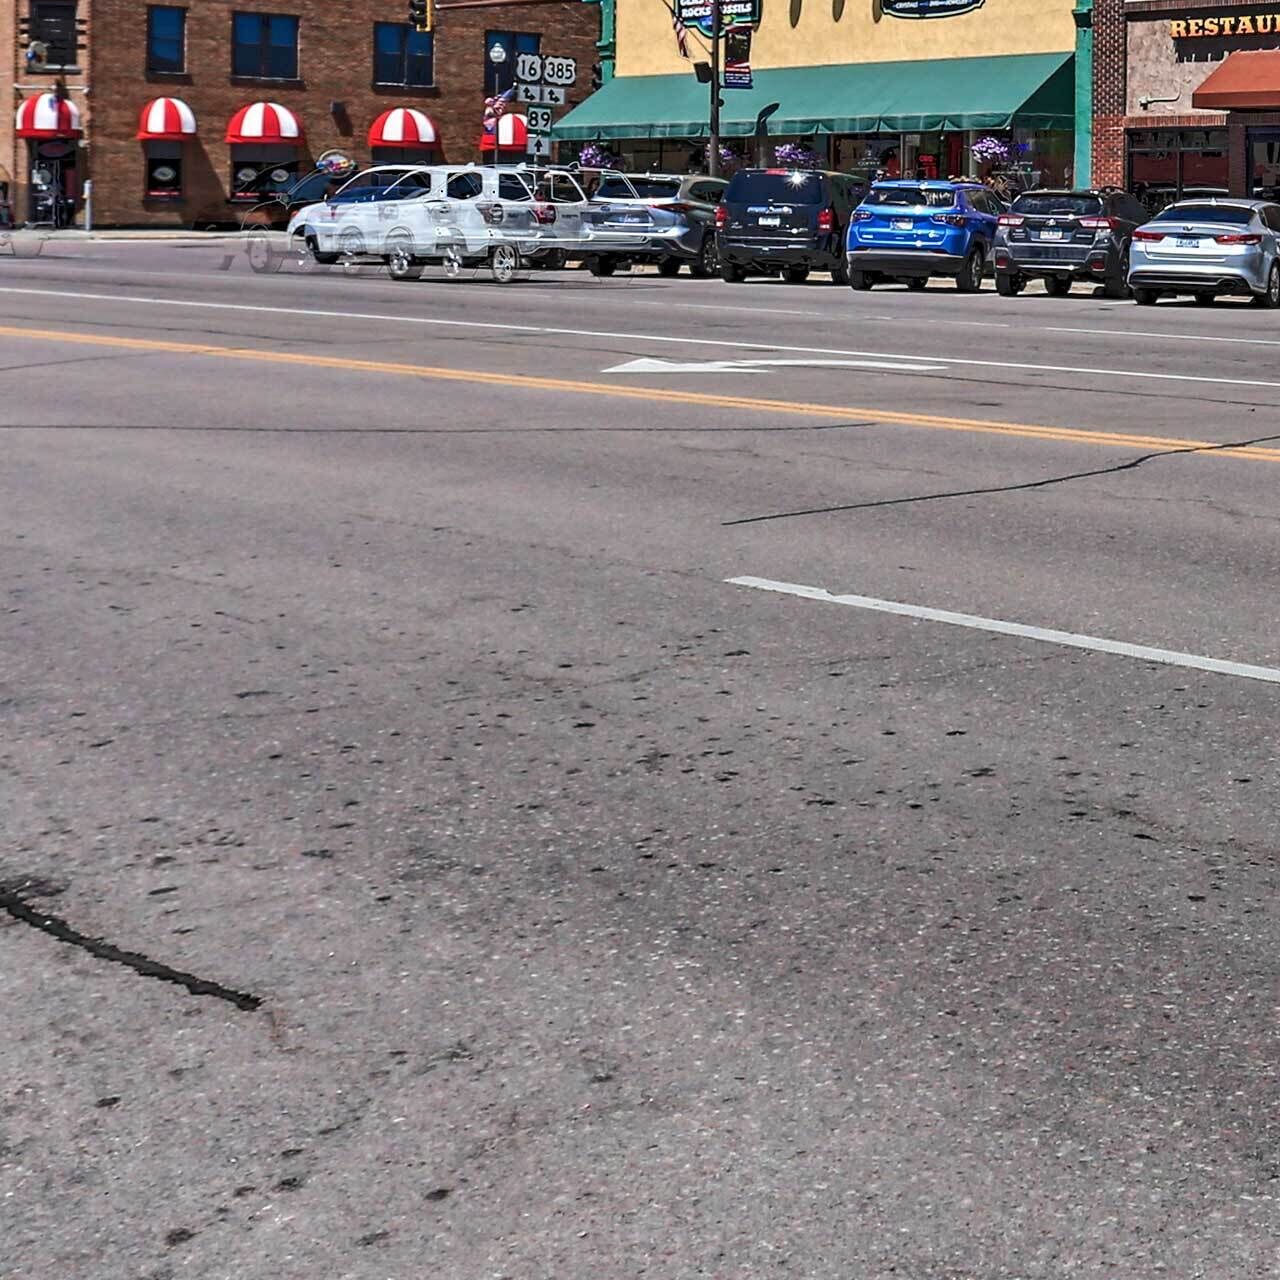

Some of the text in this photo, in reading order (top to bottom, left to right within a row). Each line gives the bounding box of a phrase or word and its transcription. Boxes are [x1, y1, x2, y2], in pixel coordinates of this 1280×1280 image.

[520, 60, 537, 77] 16
[547, 62, 573, 80] 385
[528, 110, 550, 128] 89
